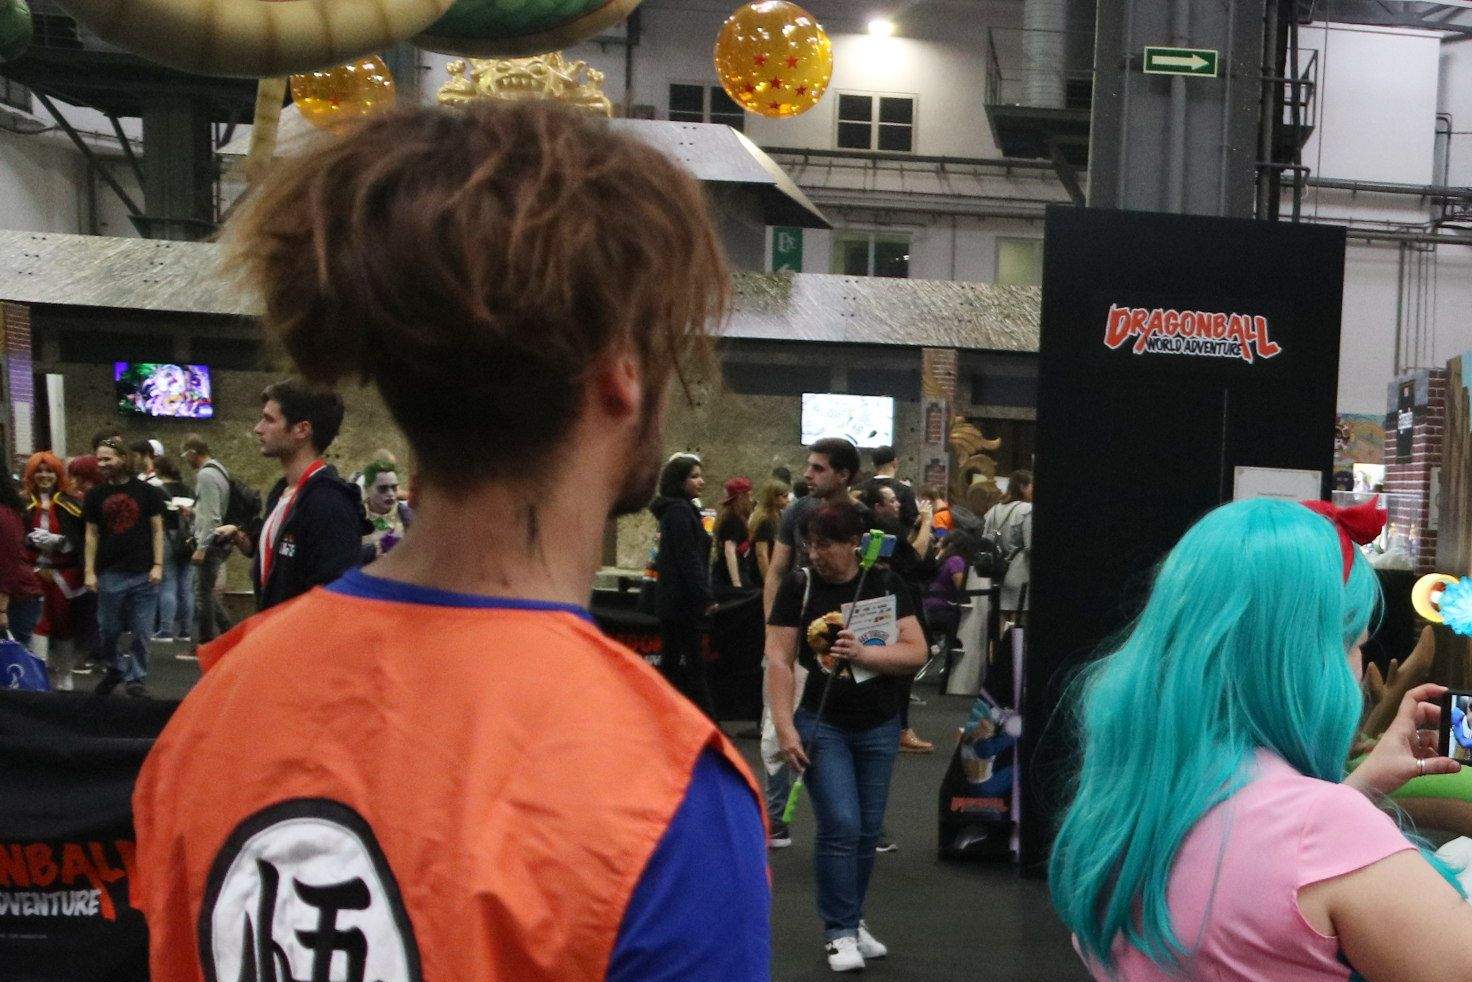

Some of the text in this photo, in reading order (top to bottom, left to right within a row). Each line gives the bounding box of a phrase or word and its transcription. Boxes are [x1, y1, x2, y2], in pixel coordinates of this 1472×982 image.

[1104, 303, 1282, 364] DRAGONBALL
[1146, 337, 1242, 357] WORLD ADVENTURE
